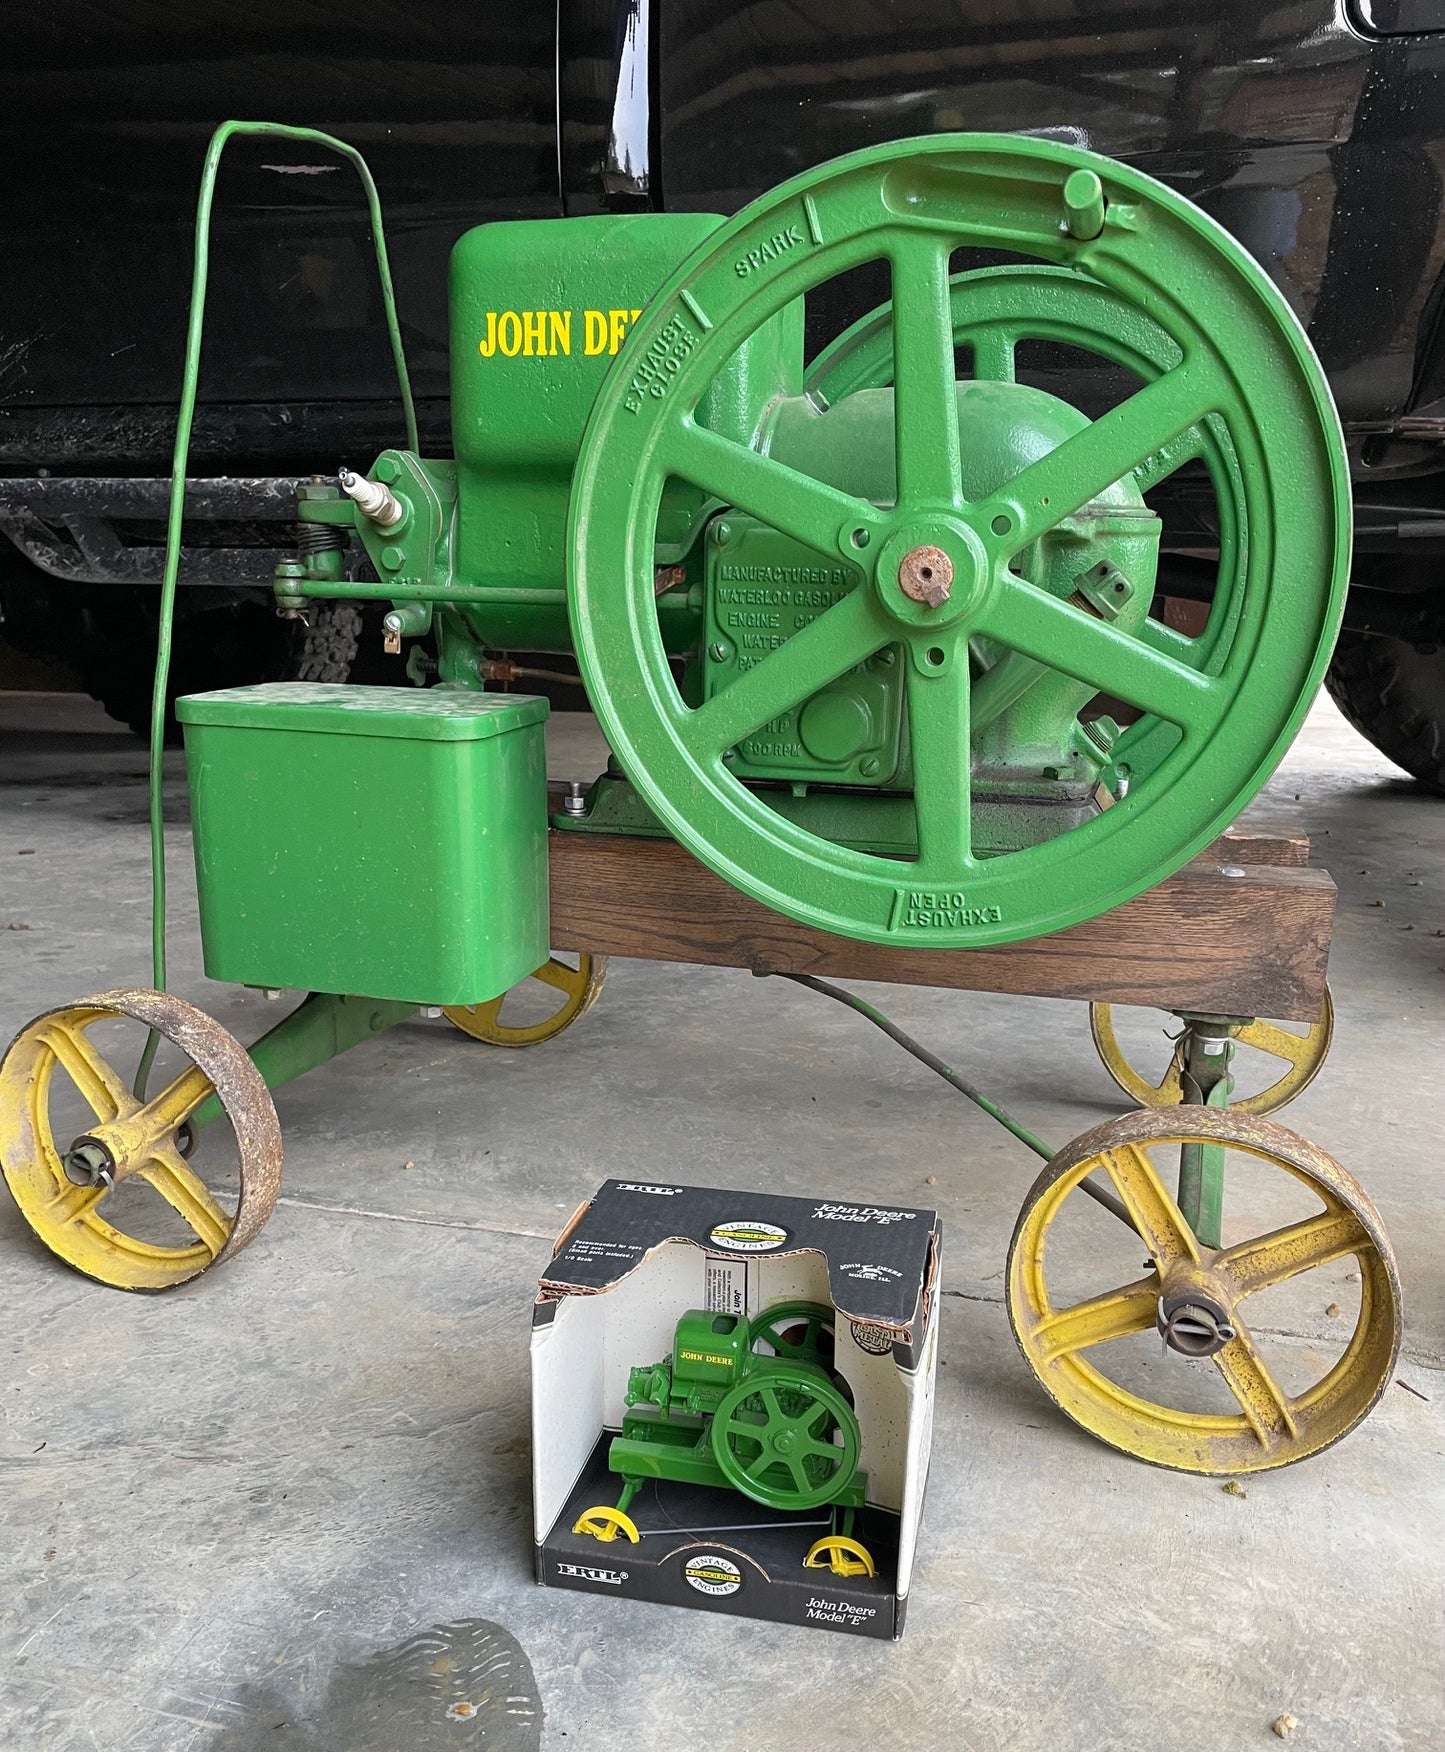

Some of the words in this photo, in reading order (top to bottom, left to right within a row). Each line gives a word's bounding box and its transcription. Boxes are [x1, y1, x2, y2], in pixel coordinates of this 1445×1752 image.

[733, 225, 805, 278] SPARK
[479, 311, 571, 357] JOHN
[584, 310, 642, 355] DE
[624, 313, 686, 415] EXHAUST
[648, 329, 702, 400] CLOSE
[720, 566, 827, 583] MANUFACTURED
[831, 569, 851, 585] BY
[718, 588, 791, 606] WATERLOO
[728, 612, 780, 629] ENGINE
[774, 743, 801, 757] RPM
[909, 892, 965, 910] OPEN
[904, 905, 1002, 928] EXHAUST
[810, 1211, 870, 1223] Model
[814, 1203, 860, 1215] John
[860, 1207, 917, 1220] Deere
[721, 1223, 779, 1234] VINTAGE
[717, 1237, 776, 1249] ENGINES
[839, 1263, 861, 1271] JOHN
[876, 1265, 904, 1278] DEERE
[734, 1289, 742, 1308] Join
[680, 1351, 703, 1361] JOHN
[705, 1355, 734, 1366] DEERE
[691, 1558, 734, 1572] VINTAGE
[693, 1570, 733, 1581] GASOLINE
[693, 1578, 735, 1593] ENGINES
[805, 1597, 837, 1610] John
[837, 1602, 877, 1617] Deere
[806, 1608, 846, 1623] Model
